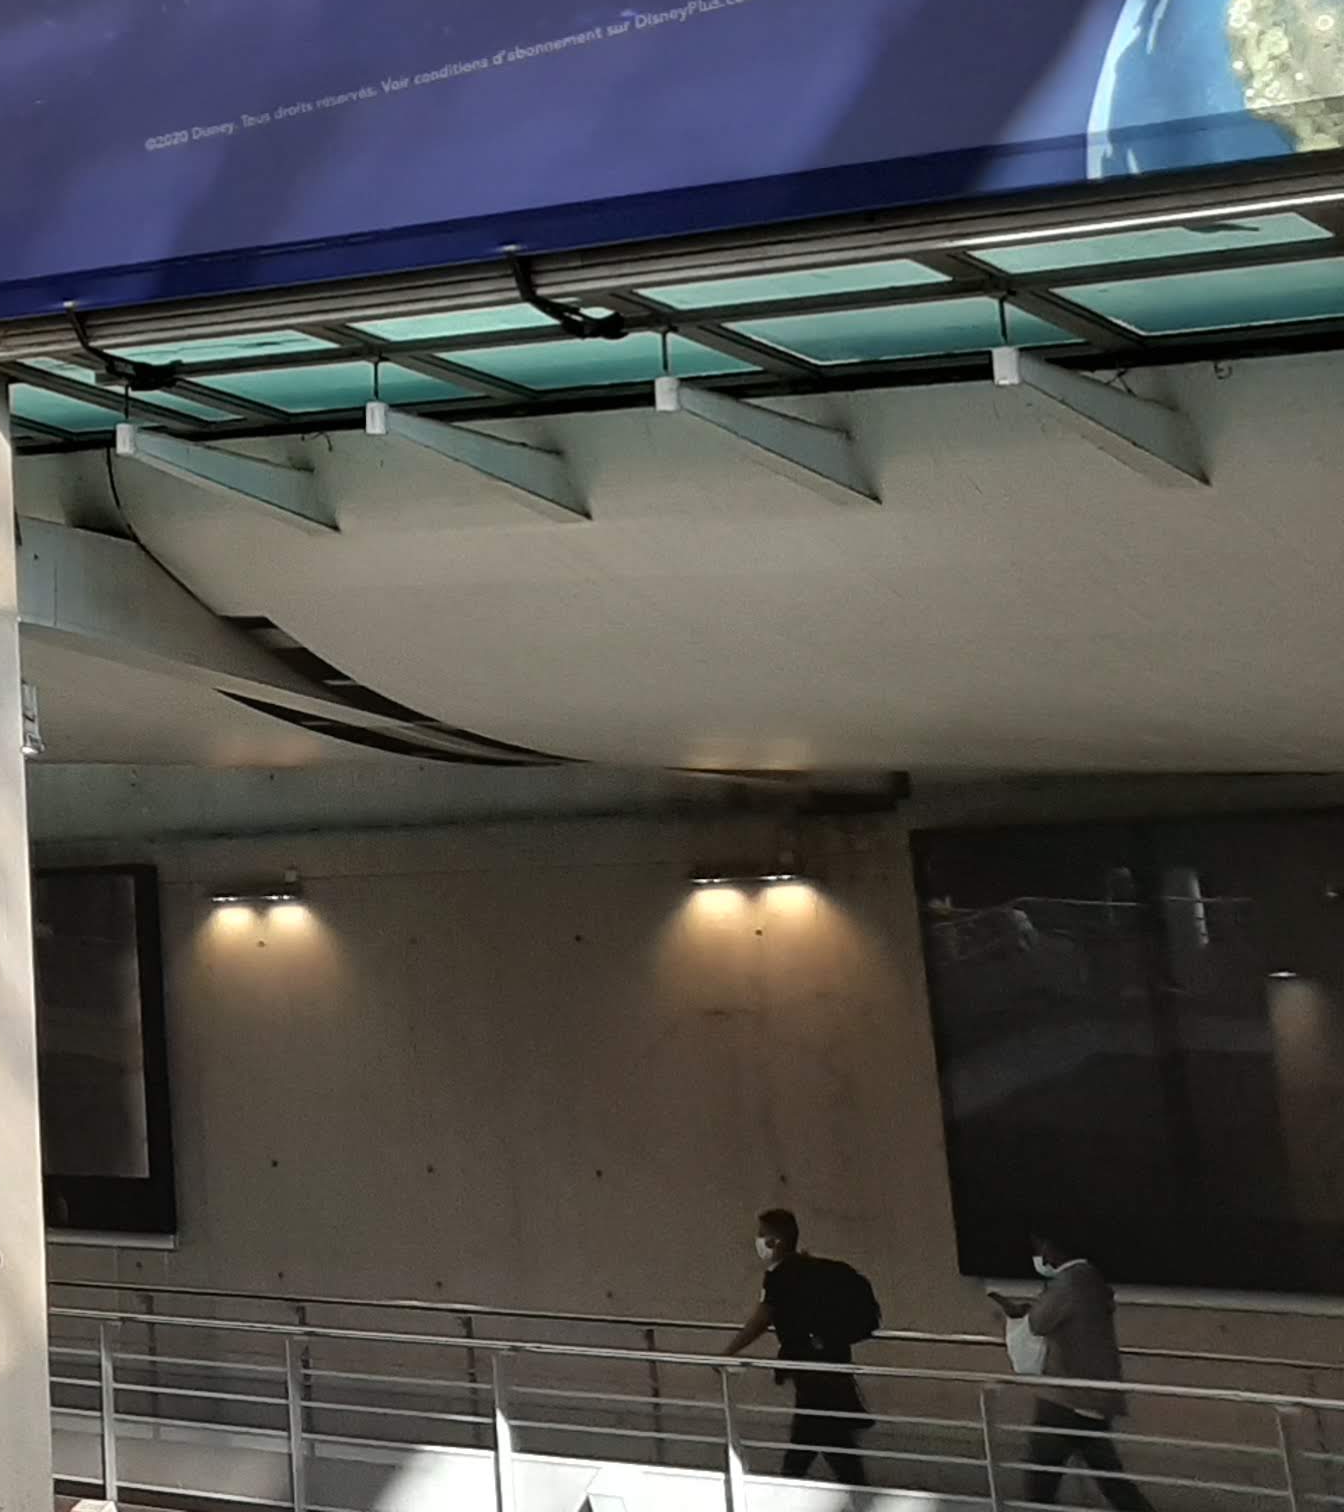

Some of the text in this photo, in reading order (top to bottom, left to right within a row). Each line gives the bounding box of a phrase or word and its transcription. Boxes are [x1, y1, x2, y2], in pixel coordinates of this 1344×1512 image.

[381, 76, 409, 93] Voir
[413, 58, 489, 85] conditions
[607, 21, 630, 38] sur
